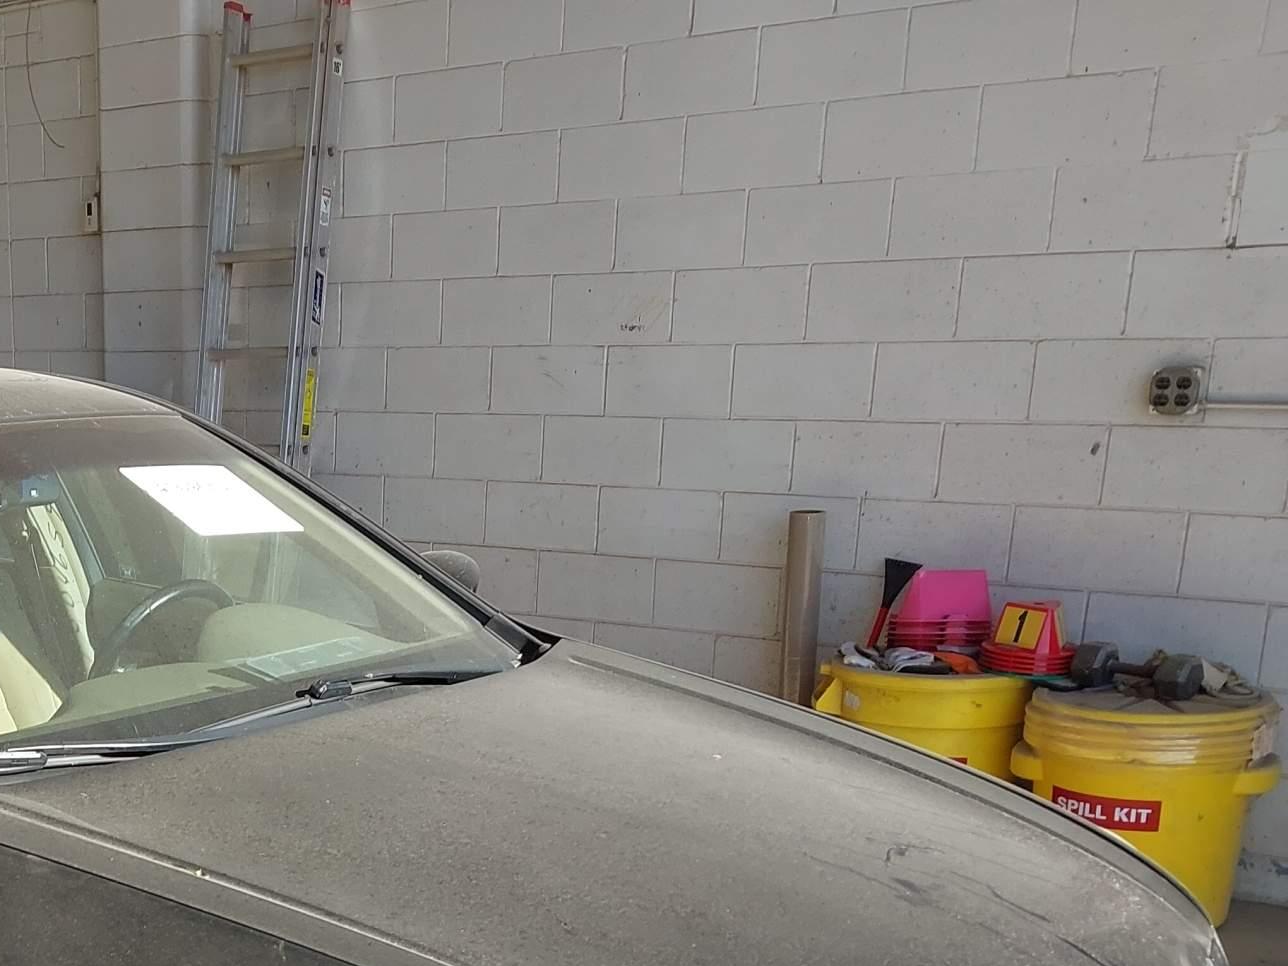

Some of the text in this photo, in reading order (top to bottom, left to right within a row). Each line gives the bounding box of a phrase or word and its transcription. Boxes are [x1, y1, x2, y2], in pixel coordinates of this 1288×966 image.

[1013, 610, 1029, 643] 1
[1056, 796, 1153, 824] SPILL KIT
